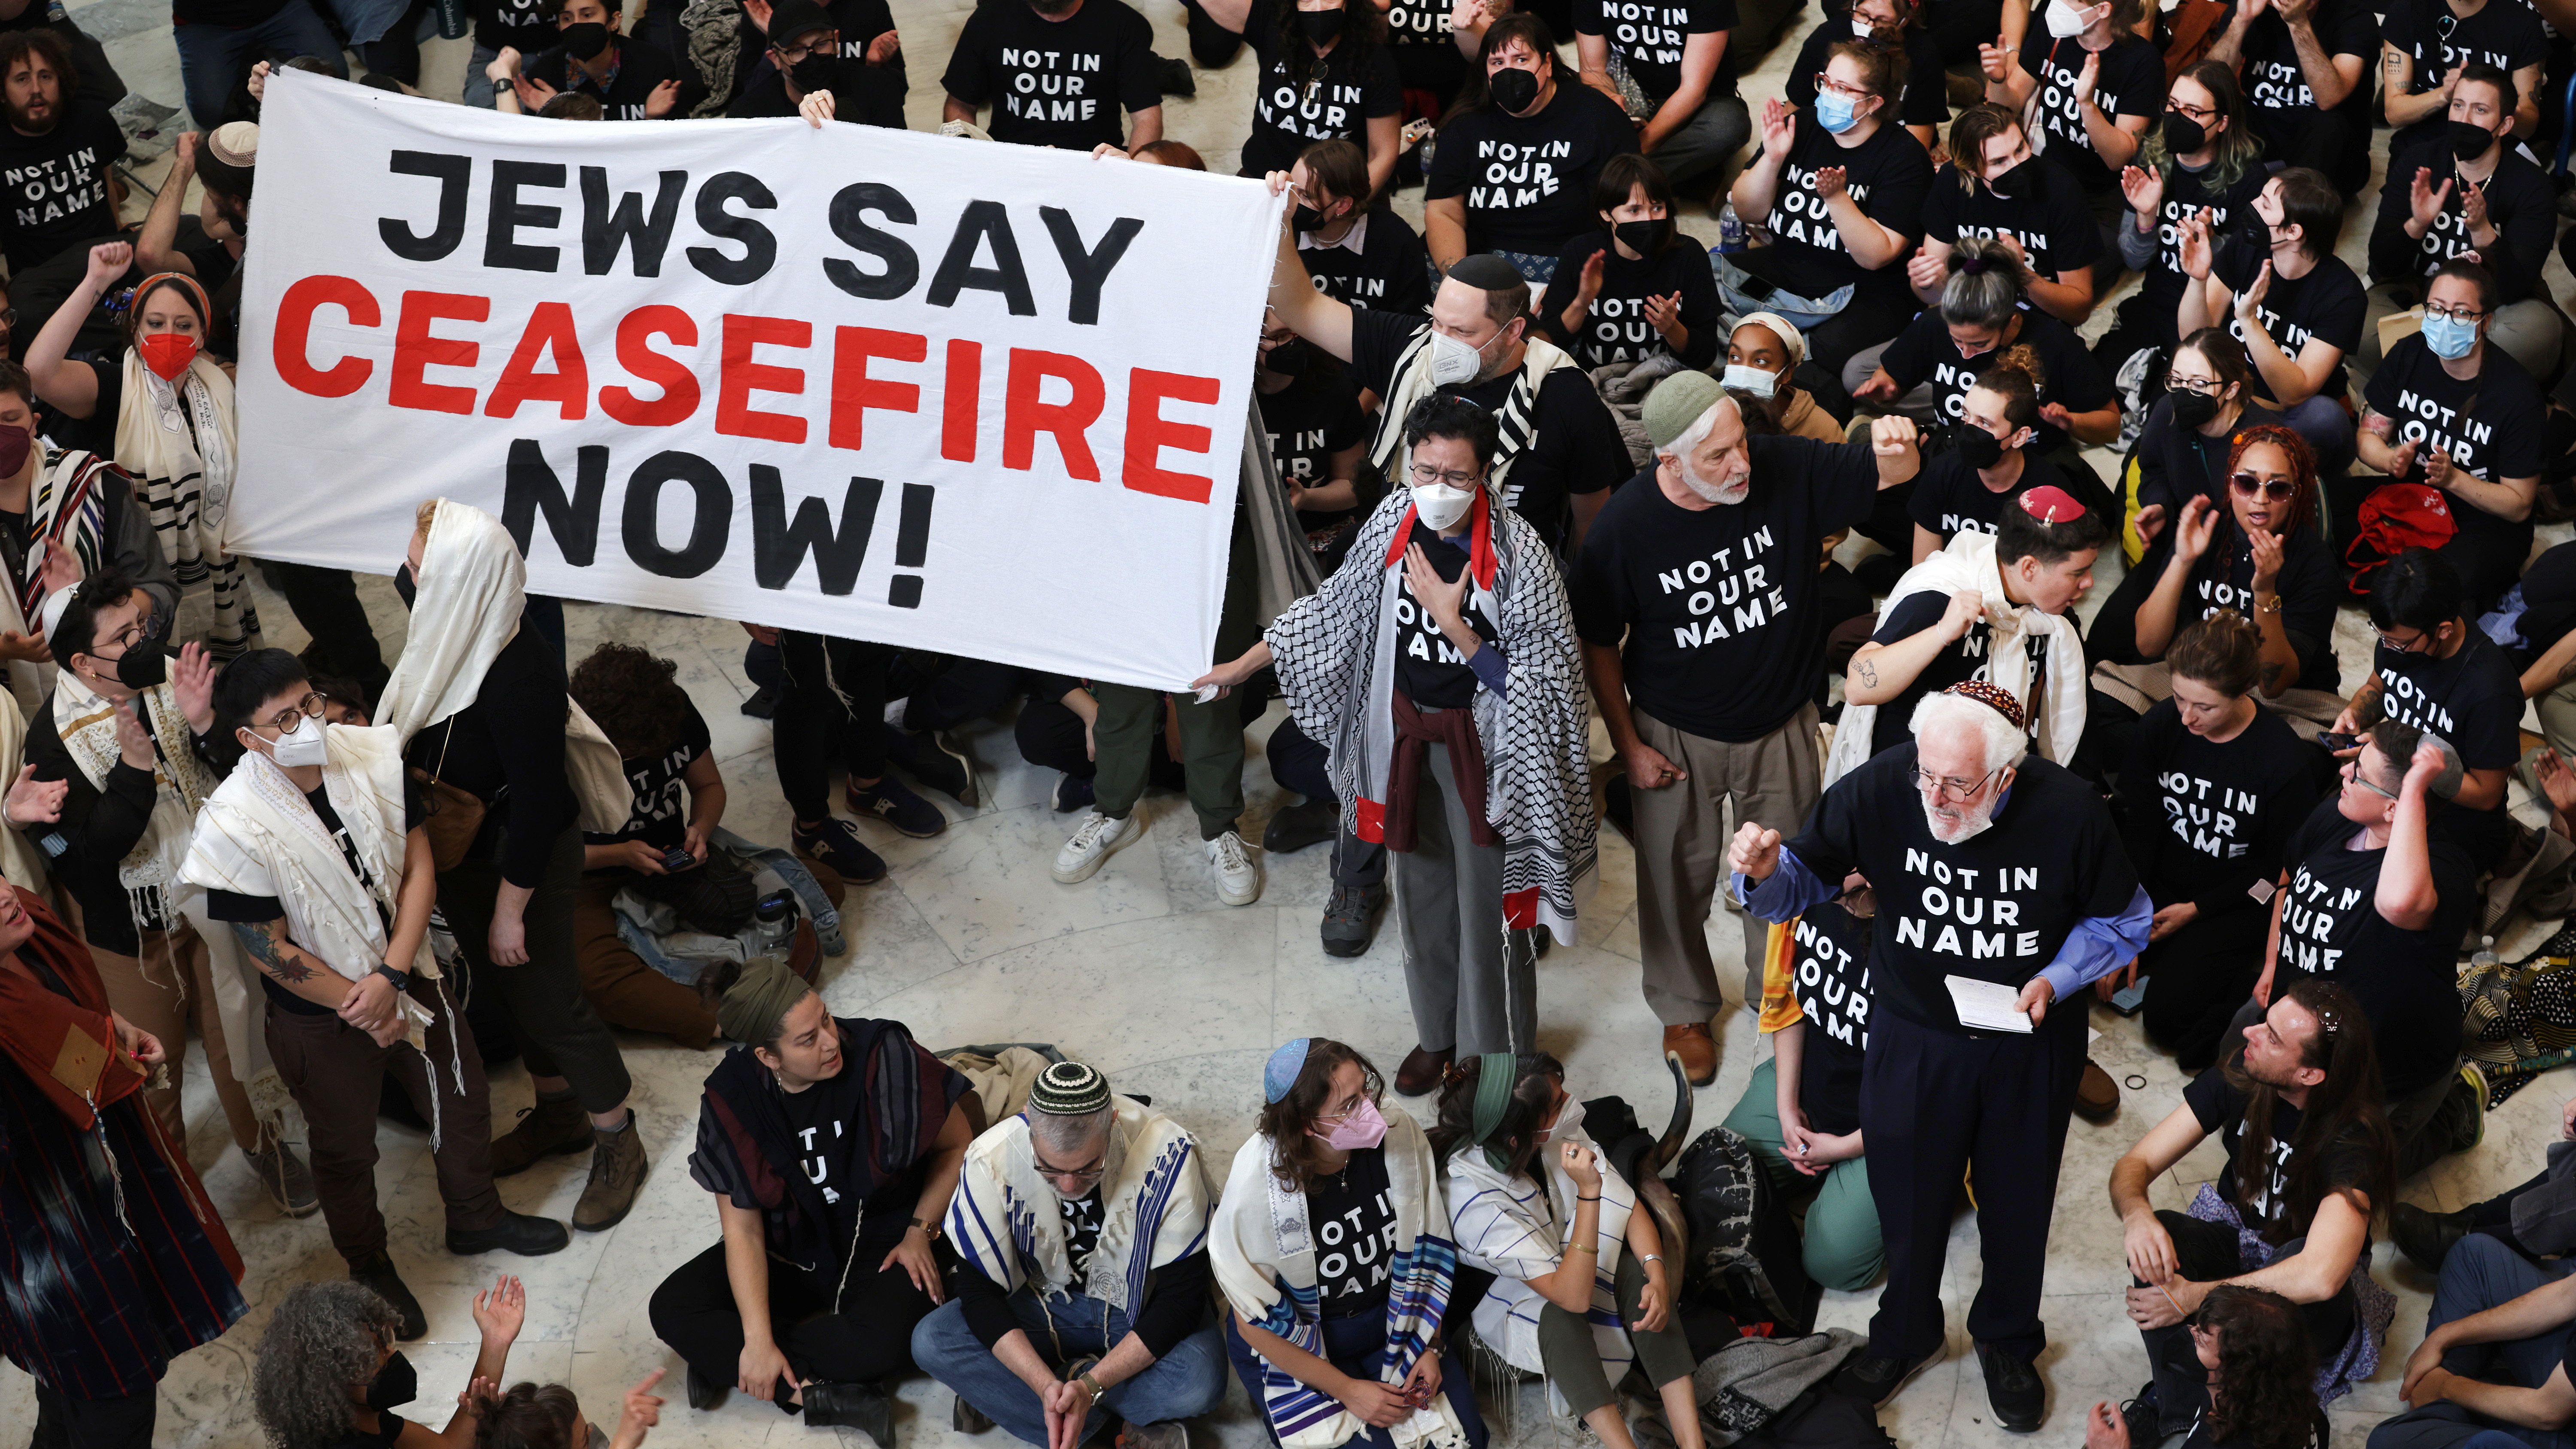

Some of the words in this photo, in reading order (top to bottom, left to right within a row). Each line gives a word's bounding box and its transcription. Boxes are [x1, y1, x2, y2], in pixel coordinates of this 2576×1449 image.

[1389, 7, 1453, 33] OUR
[1603, 1, 1656, 21] NOT
[1663, 8, 1688, 25] IN
[1617, 24, 1683, 45] OUR
[1002, 48, 1060, 69] NOT
[1072, 53, 1100, 72] IN
[2252, 60, 2296, 83] NOT
[2485, 51, 2507, 71] IN
[1015, 72, 1084, 96] OUR
[1334, 85, 1361, 104] IN
[2254, 82, 2315, 104] OUR
[1005, 92, 1098, 122] NAME
[1274, 87, 1346, 127] OUR
[2044, 86, 2085, 128] OU
[2093, 88, 2117, 113] IN
[5, 159, 56, 186] NOT
[68, 146, 97, 172] IN
[1479, 140, 1536, 161] NOT
[1540, 140, 1571, 158] IN
[25, 168, 91, 201] OUR
[1486, 162, 1552, 184] OUR
[16, 181, 106, 226] NAME
[1469, 177, 1559, 208] NAME
[1784, 191, 1834, 223] OU
[1847, 184, 1870, 201] IN
[2157, 199, 2197, 220] OT
[2433, 211, 2466, 236] OT
[378, 149, 778, 286] JEWS
[823, 182, 1145, 325] SAY
[1768, 208, 1849, 253] NAM
[2020, 230, 2047, 250] IN
[1356, 277, 1385, 297] IN
[2286, 323, 2312, 345] IN
[1440, 359, 1459, 369] BNX
[1586, 342, 1661, 364] NAM
[273, 274, 1221, 504] CEASEFIRE
[1935, 362, 1977, 391] NO
[2397, 389, 2456, 428] NOT
[2464, 418, 2492, 445] IN
[1297, 429, 1325, 451] IN
[2404, 420, 2473, 466] OUR
[501, 438, 935, 609] NOW!
[1658, 548, 1731, 594] NOT
[1742, 525, 1774, 560] IN
[1688, 564, 1768, 615] OUR
[1674, 584, 1788, 648] NAME
[2381, 668, 2426, 710] NOT
[2427, 702, 2453, 733] IN
[663, 745, 690, 777] IN
[635, 777, 680, 813] UR
[2224, 788, 2257, 815] IN
[2163, 796, 2236, 837] OUR
[2166, 813, 2249, 859] AME
[1905, 847, 1978, 891] NOT
[1999, 867, 2038, 893] IN
[2293, 861, 2329, 903] NOT
[1922, 886, 2020, 926] OUR
[2281, 894, 2334, 943] OUR
[1795, 920, 1852, 973] NOT
[1896, 916, 2039, 959] NAME
[1800, 958, 1868, 1025] OUR
[1321, 1206, 1362, 1245] OT
[1319, 1220, 1397, 1278] OUR
